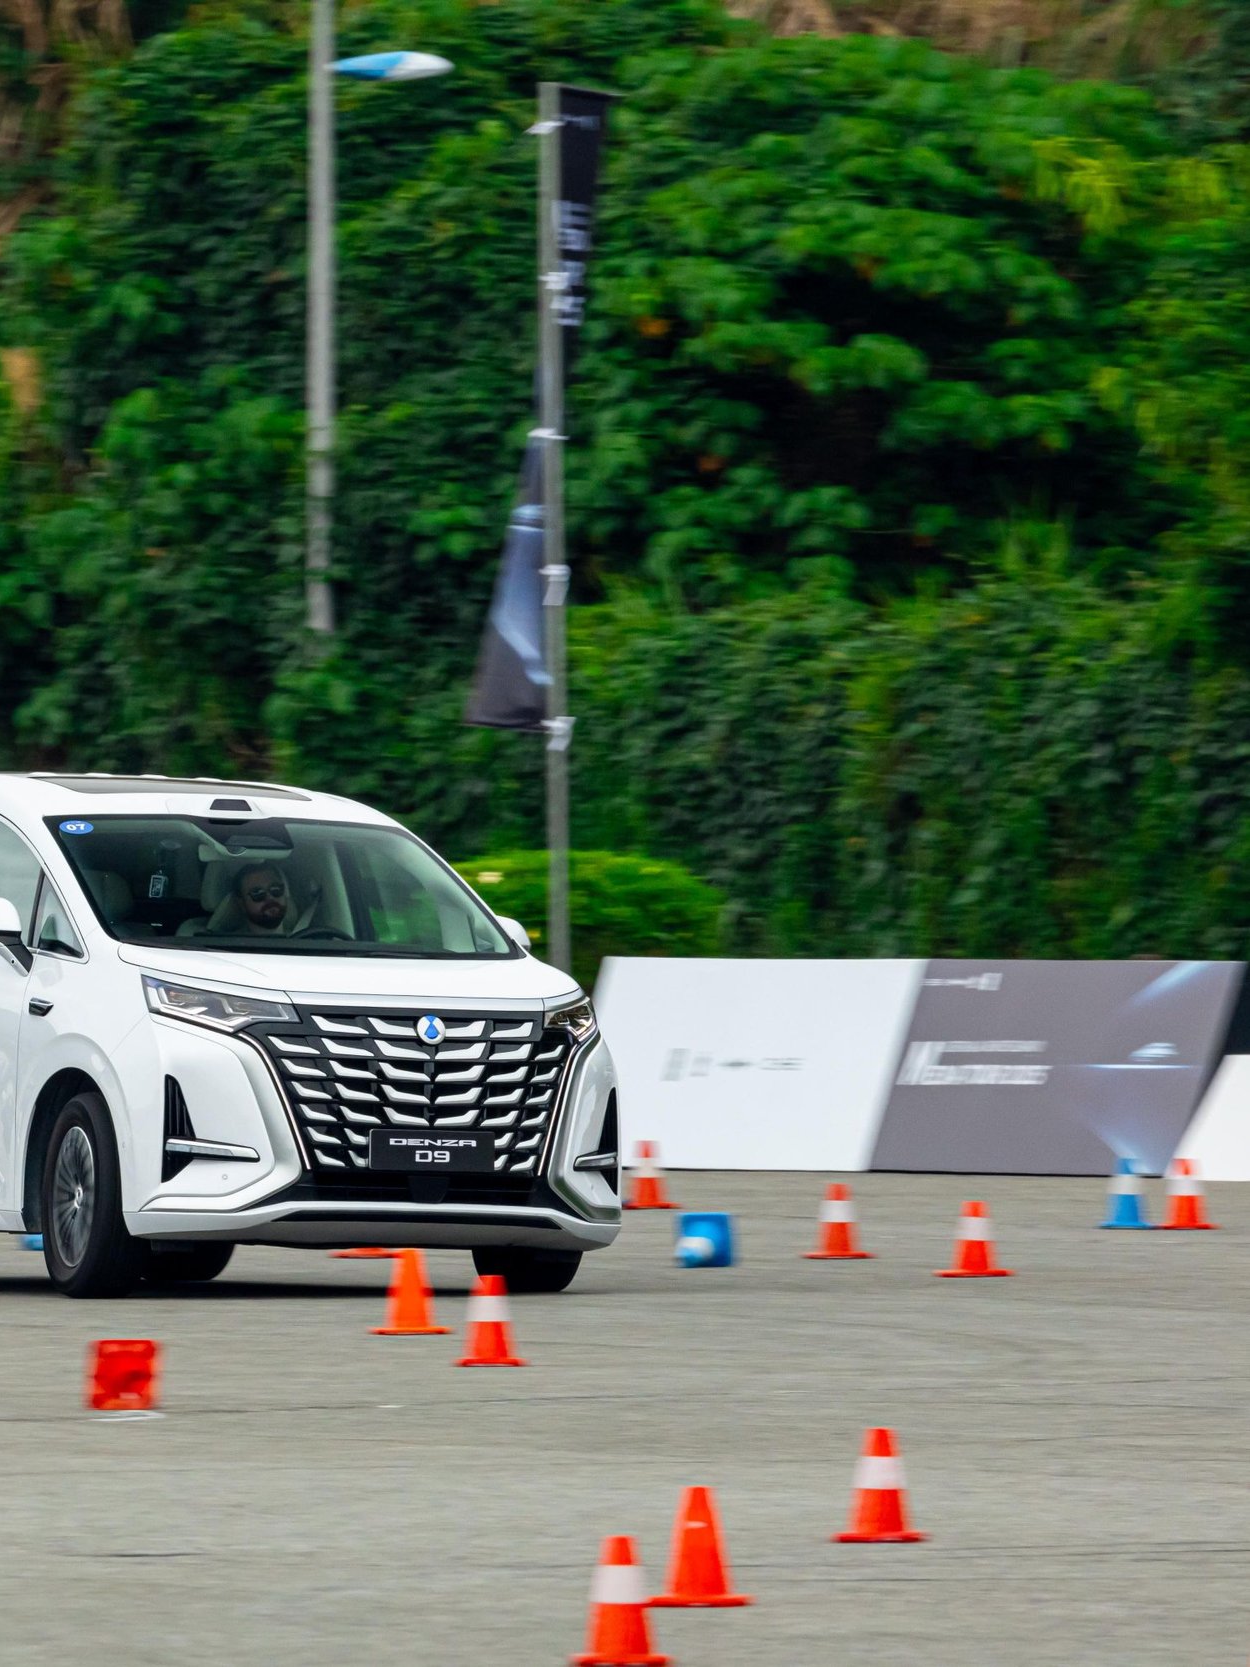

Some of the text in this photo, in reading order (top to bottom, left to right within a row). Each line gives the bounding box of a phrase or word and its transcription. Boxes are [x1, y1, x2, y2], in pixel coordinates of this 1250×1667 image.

[66, 823, 85, 831] 07
[389, 1138, 477, 1147] DENZA
[415, 1150, 450, 1163] D9
